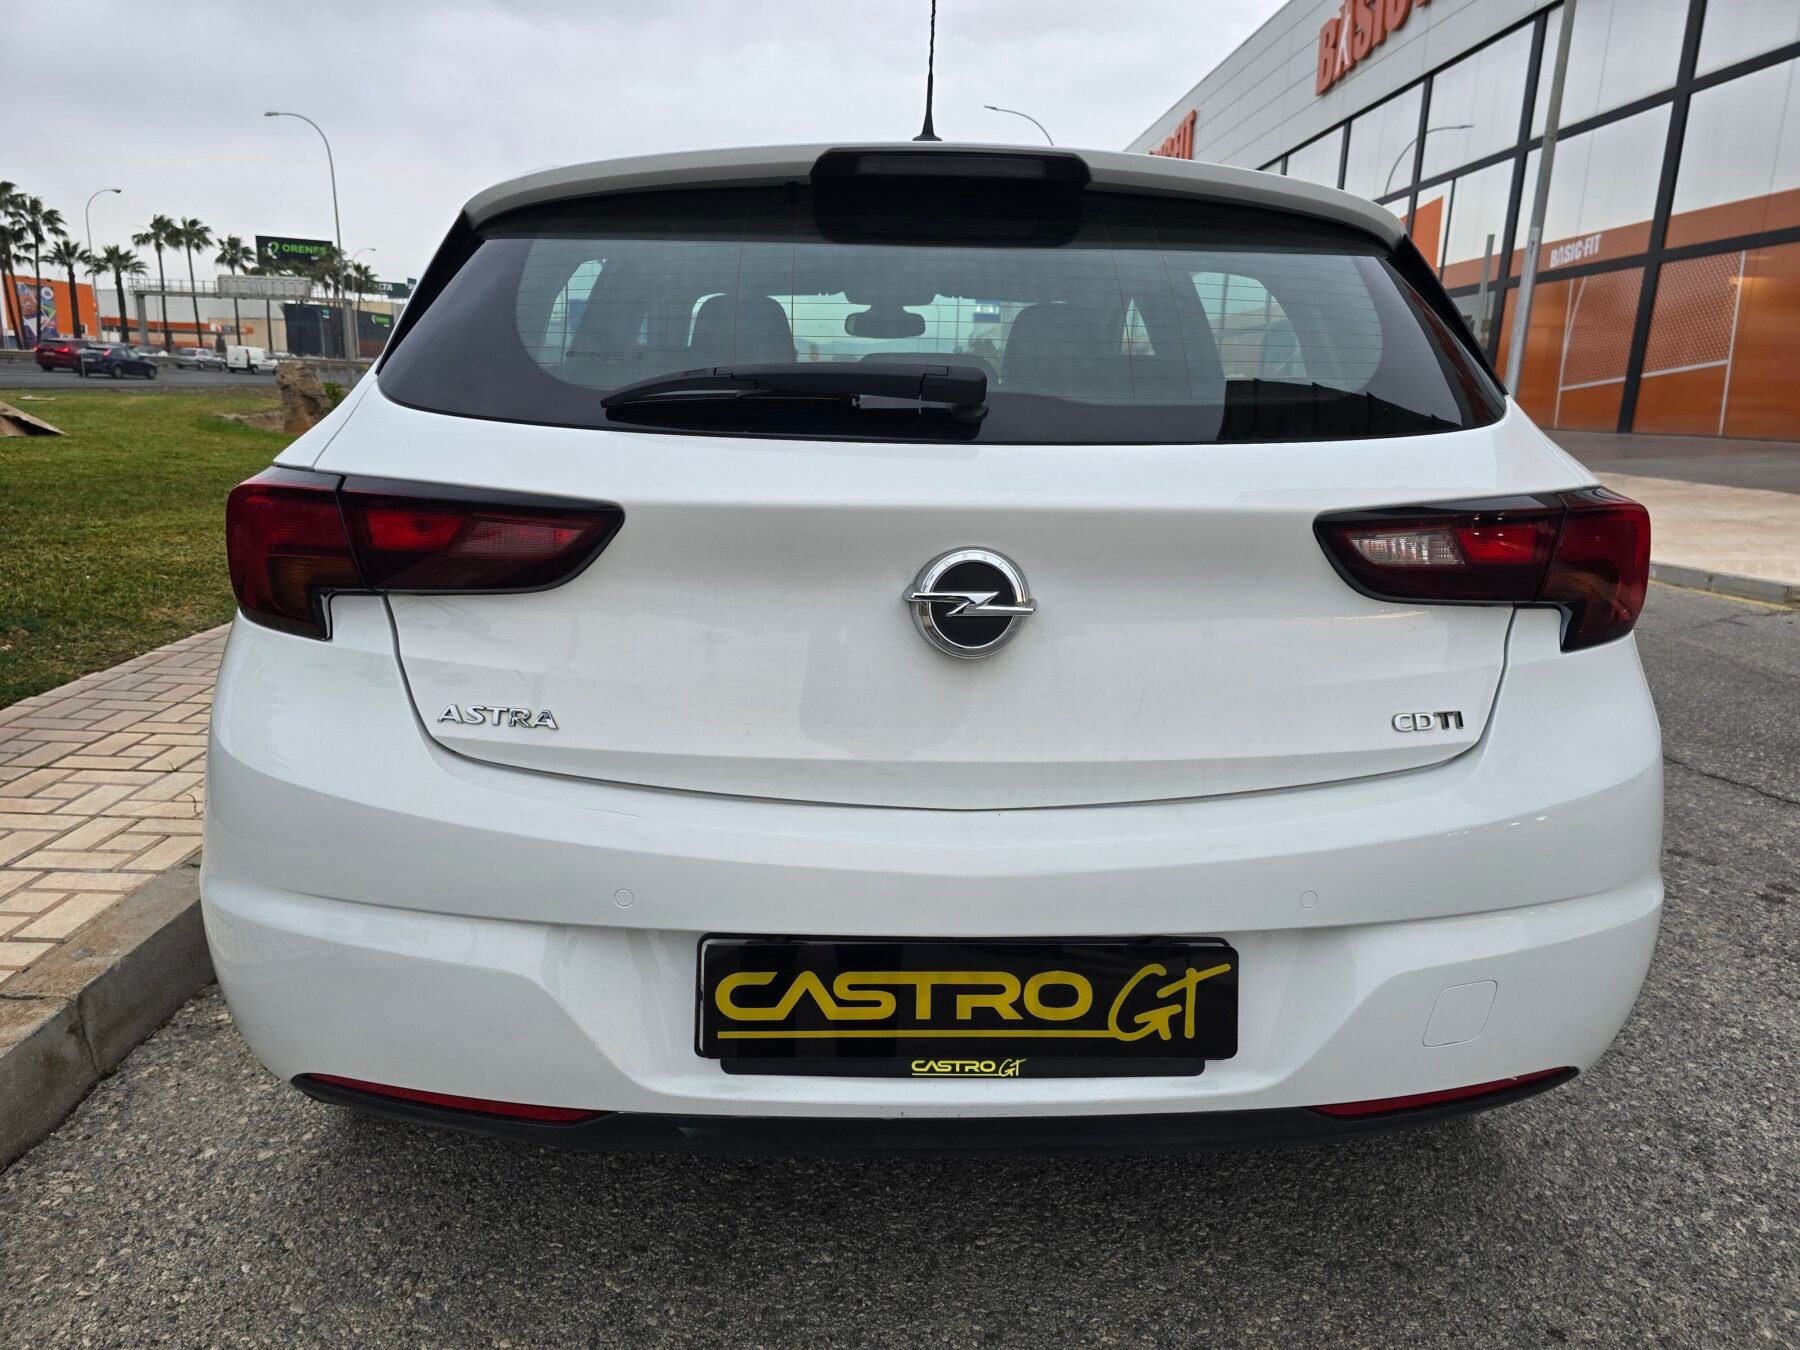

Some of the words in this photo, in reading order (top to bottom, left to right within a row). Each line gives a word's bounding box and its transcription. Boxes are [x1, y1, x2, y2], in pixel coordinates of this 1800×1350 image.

[437, 703, 559, 730] ASTRA
[1391, 710, 1464, 733] CDTI
[715, 970, 1093, 1021] CASTRO
[1107, 963, 1231, 1041] GT
[911, 1060, 996, 1073] CASTRO
[998, 1058, 1027, 1077] GT
